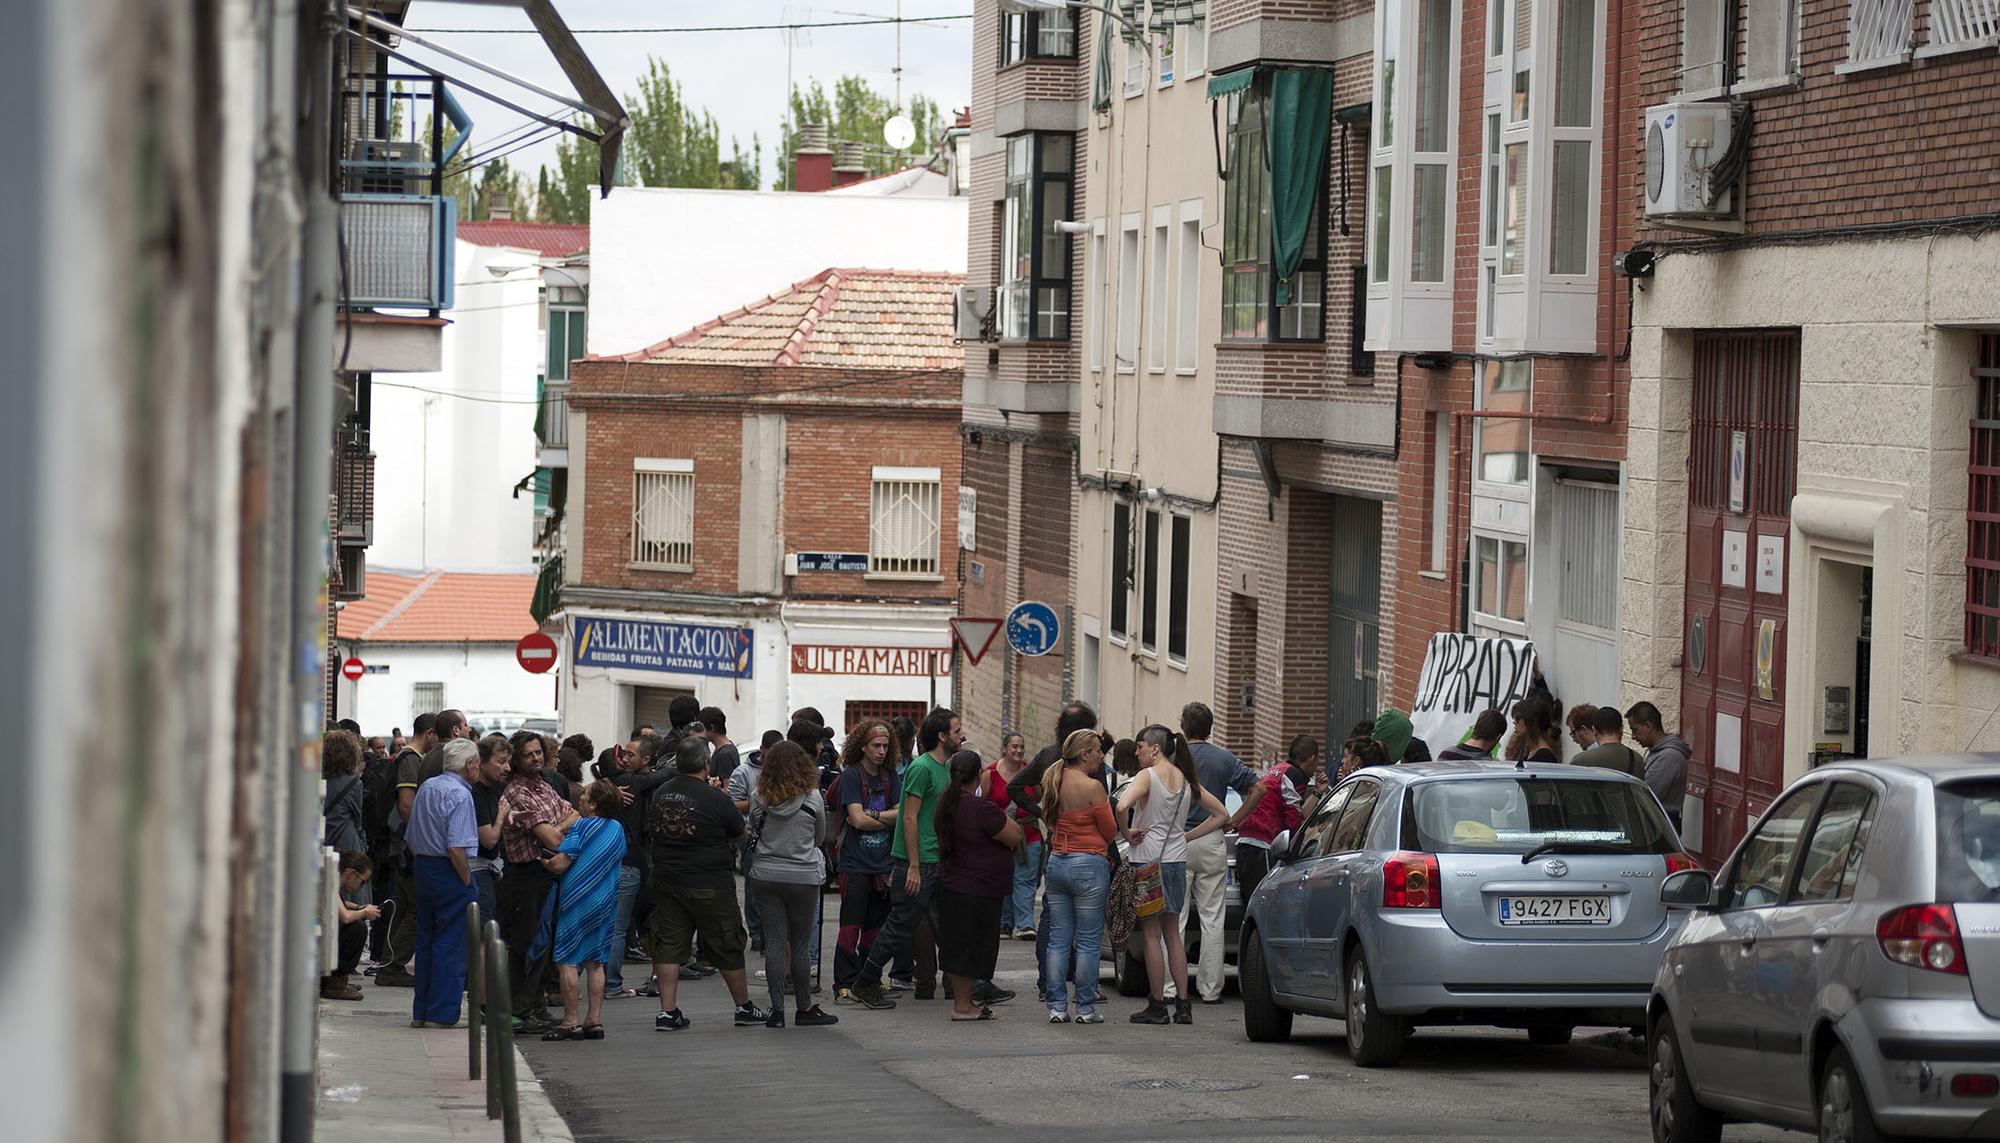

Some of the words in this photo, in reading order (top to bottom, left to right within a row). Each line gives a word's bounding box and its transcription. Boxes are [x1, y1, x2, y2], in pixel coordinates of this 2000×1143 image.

[838, 562, 867, 570] BAUTISTA
[589, 621, 738, 658] ALIMENTACION
[591, 651, 627, 663] BEBIDAS
[631, 653, 663, 666] FRUTAS
[666, 657, 704, 669] PATATAS
[708, 661, 714, 670] Y
[717, 661, 736, 672] MAS
[1514, 899, 1563, 917] 9427
[1569, 899, 1606, 917] FGX
